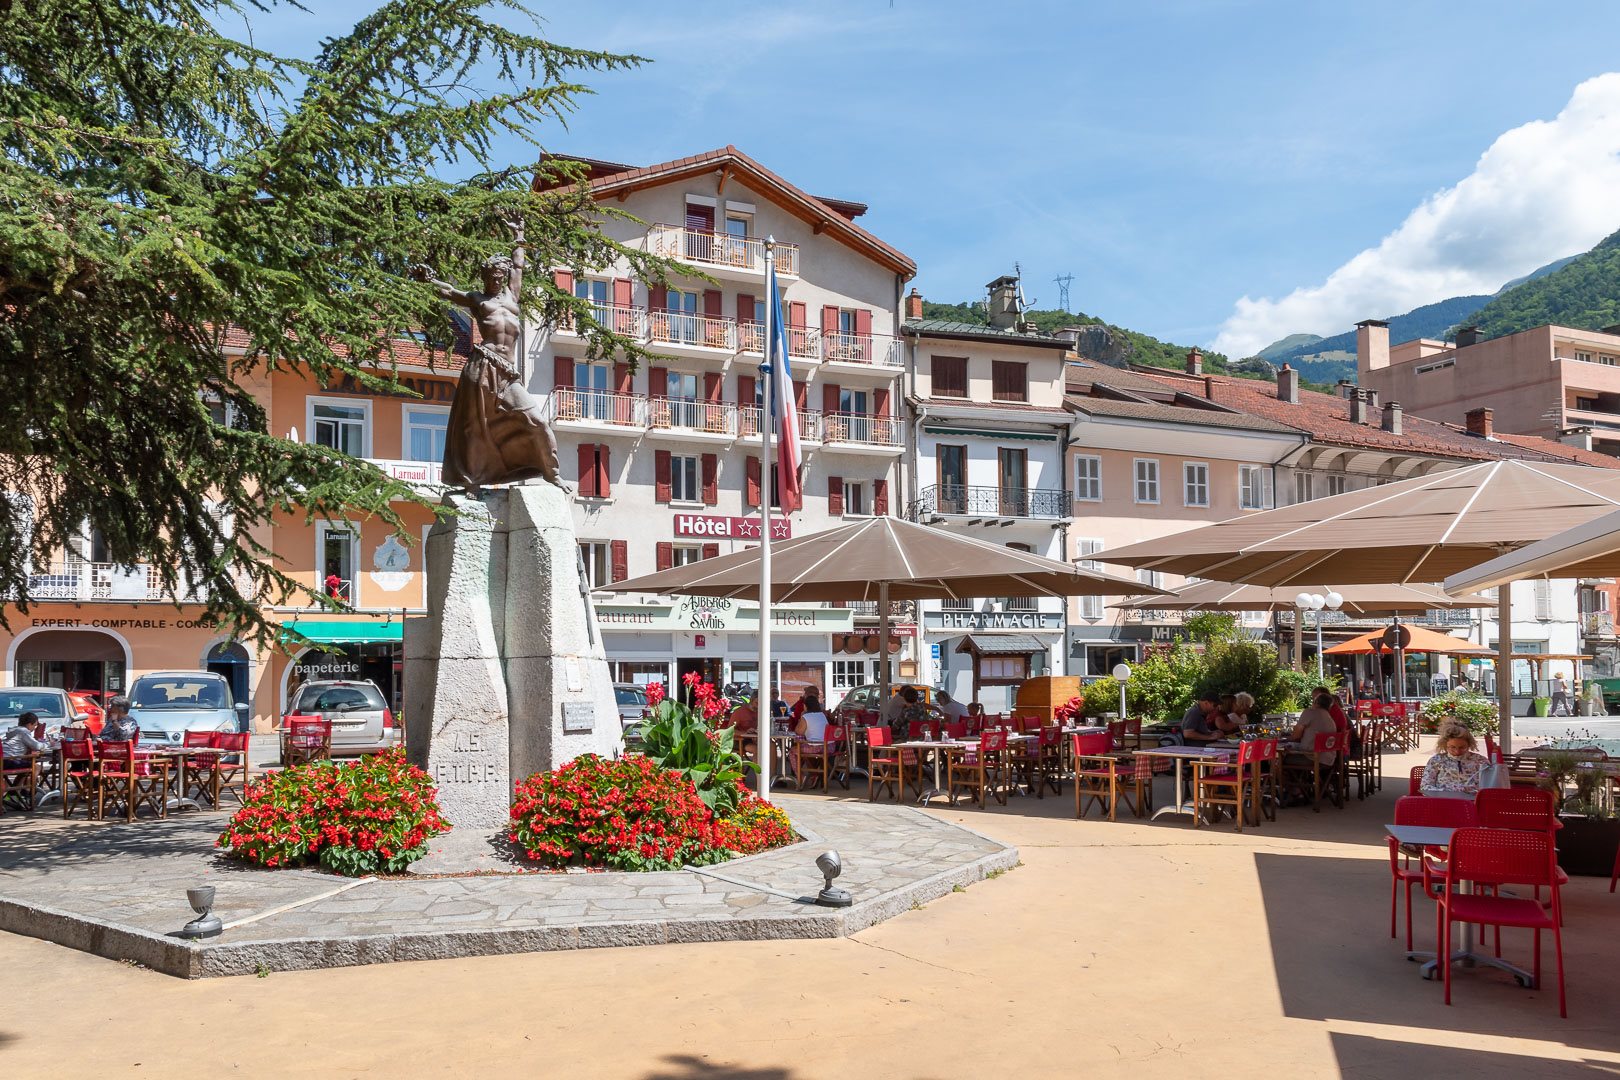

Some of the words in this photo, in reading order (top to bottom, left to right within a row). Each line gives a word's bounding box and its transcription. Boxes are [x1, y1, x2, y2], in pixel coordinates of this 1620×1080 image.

[393, 468, 426, 480] Larnaud
[678, 516, 732, 536] Hôtel
[32, 618, 82, 628] EXPERT
[92, 619, 166, 629] COMPTABLE
[775, 611, 816, 626] Hôtel
[943, 613, 1047, 628] PHARMACIE
[1152, 627, 1170, 639] MH
[294, 661, 360, 677] papeterie
